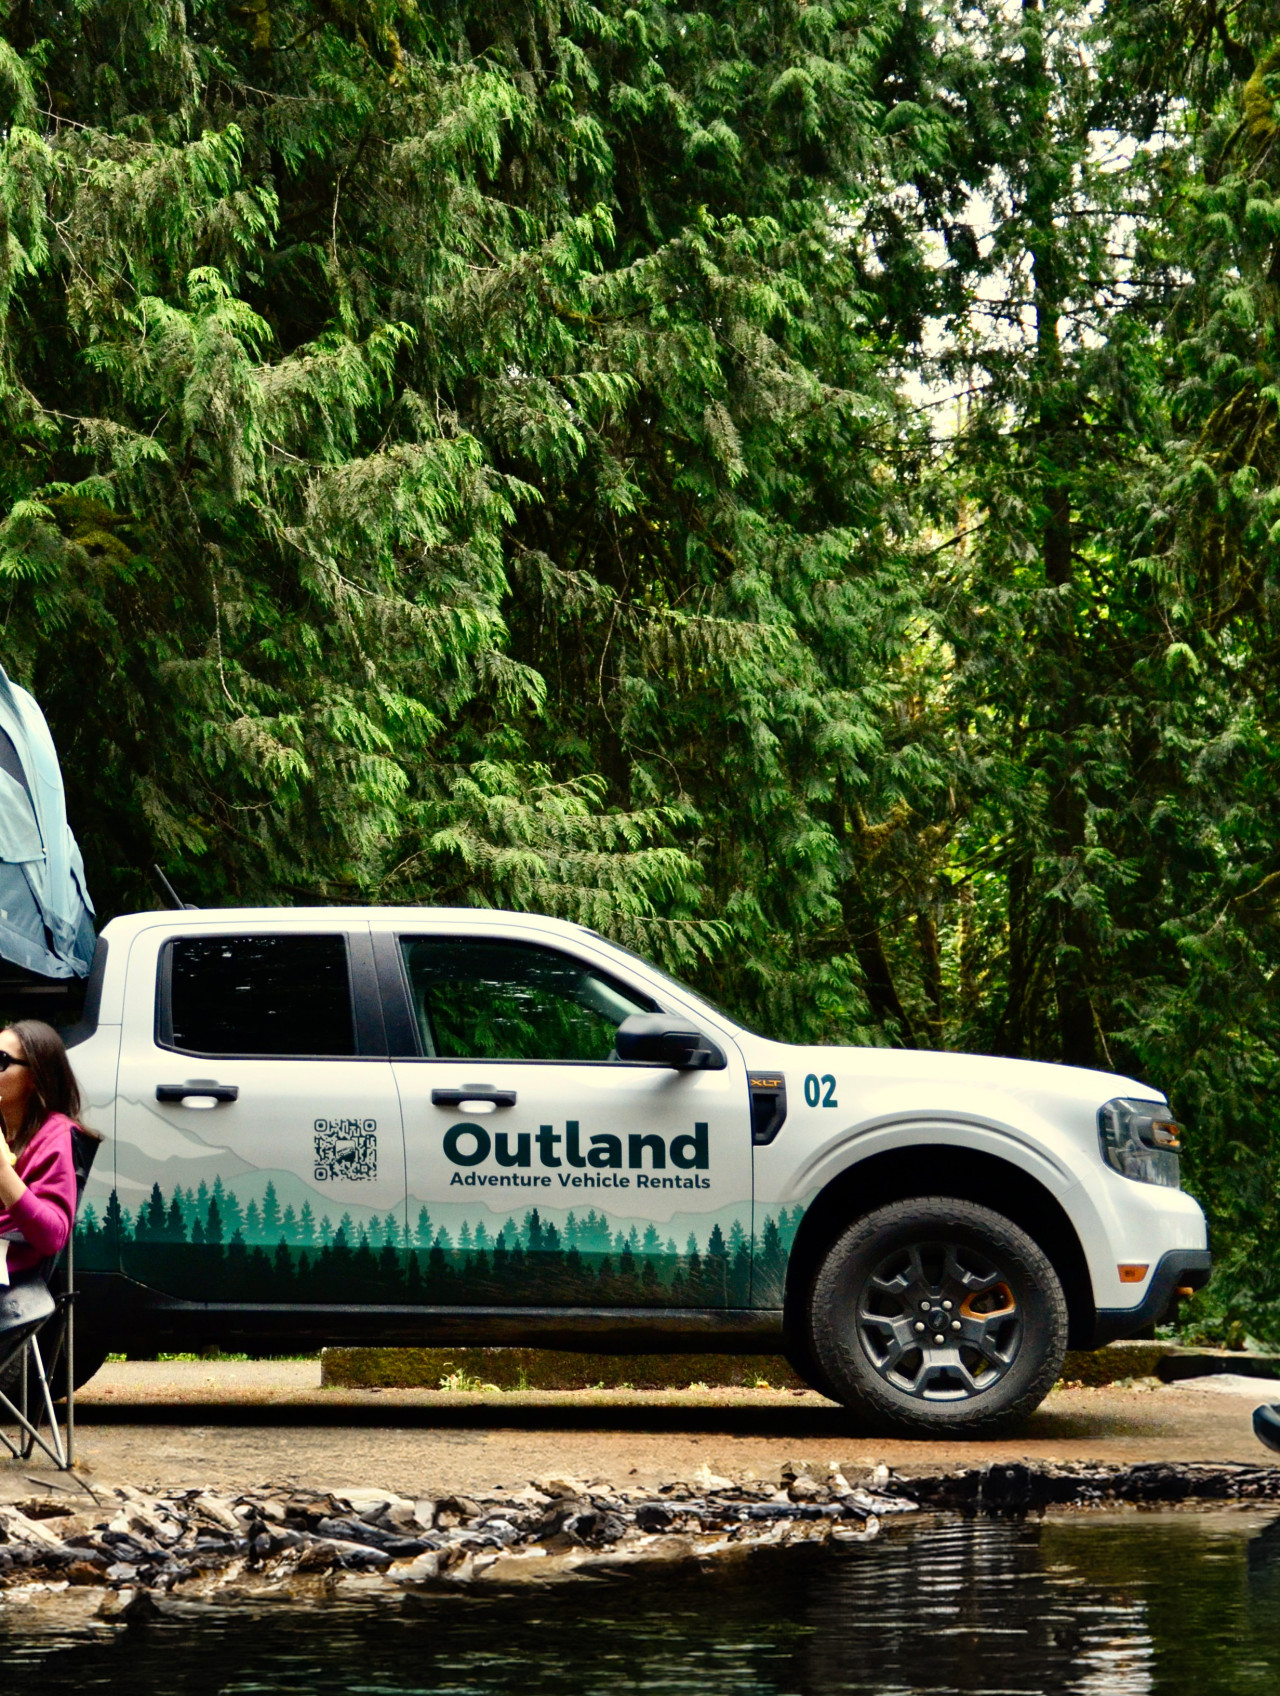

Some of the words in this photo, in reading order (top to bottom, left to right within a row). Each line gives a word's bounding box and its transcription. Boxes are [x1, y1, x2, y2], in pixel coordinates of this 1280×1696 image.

[750, 1079, 782, 1087] XLT
[804, 1073, 838, 1108] 02
[442, 1120, 709, 1170] Outland
[449, 1172, 552, 1187] Adventure
[557, 1173, 630, 1188] Vehicle
[637, 1174, 711, 1189] Rentals
